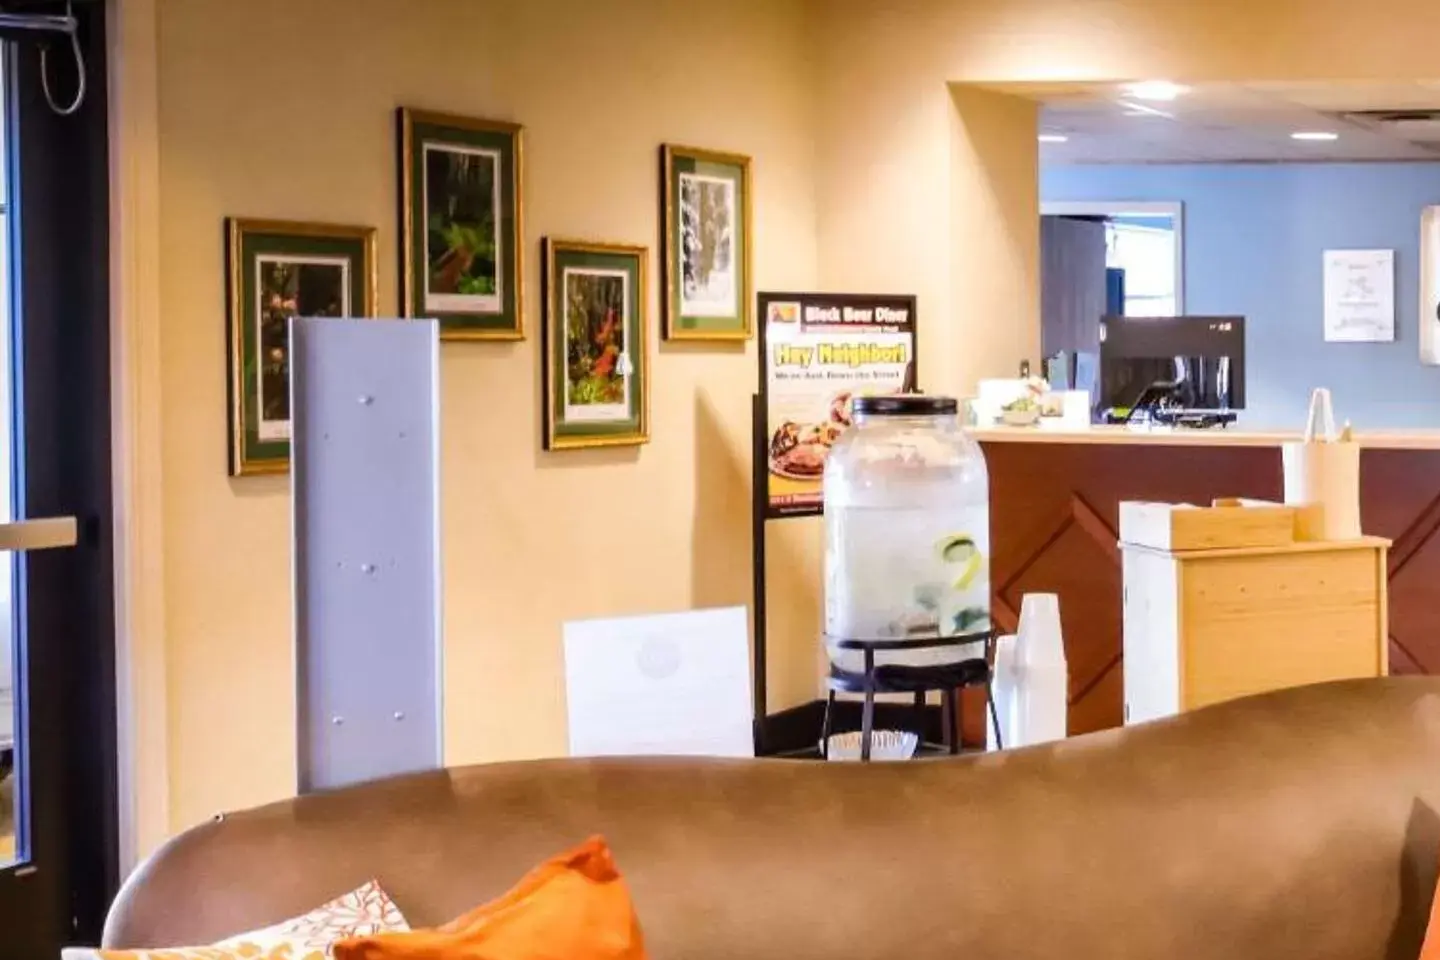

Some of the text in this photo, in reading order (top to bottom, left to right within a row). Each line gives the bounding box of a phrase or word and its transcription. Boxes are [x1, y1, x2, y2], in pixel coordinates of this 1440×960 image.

[805, 305, 908, 323] Black Bear Diner
[773, 341, 907, 369] Hey Neighbor!
